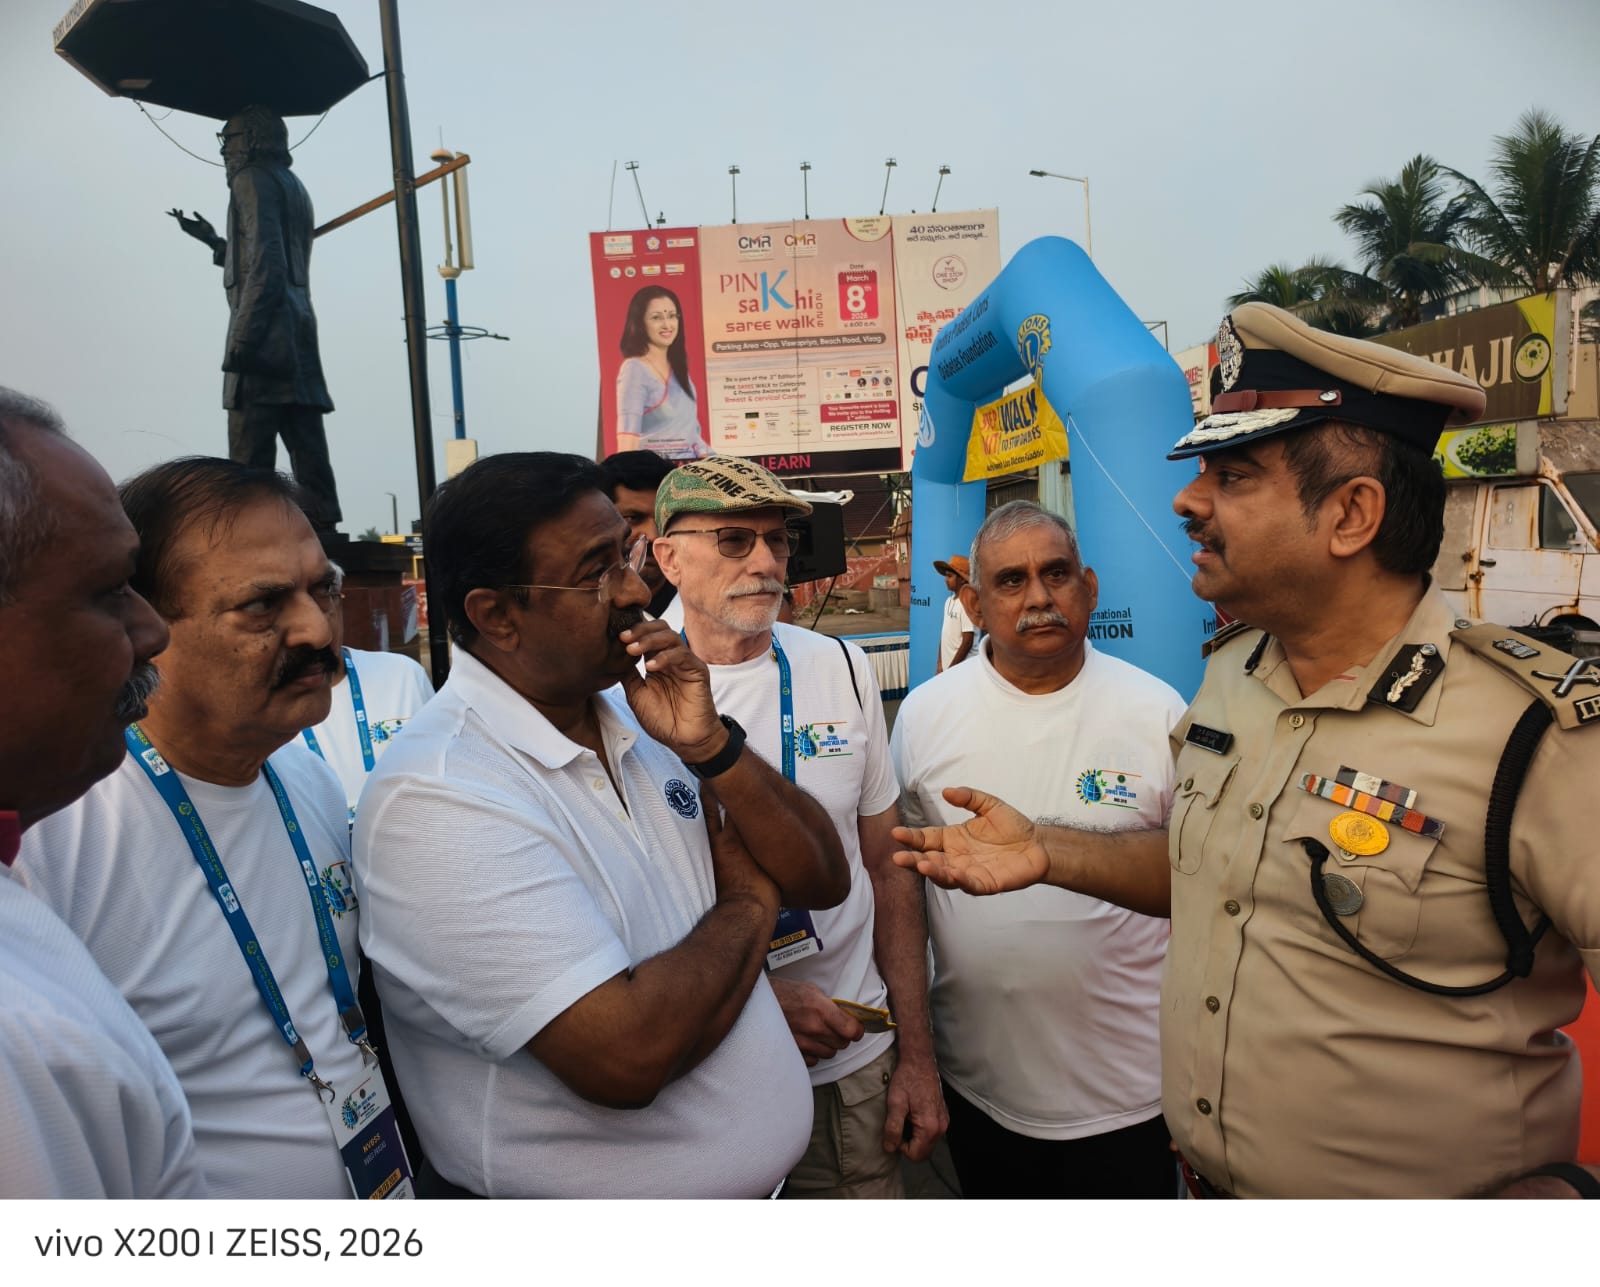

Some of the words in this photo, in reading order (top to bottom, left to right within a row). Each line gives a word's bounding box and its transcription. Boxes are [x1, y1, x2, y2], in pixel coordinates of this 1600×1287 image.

[910, 225, 925, 233] 40
[738, 235, 771, 249] CMR
[784, 233, 816, 247] CMR
[726, 319, 771, 333] saree
[776, 315, 815, 330] walk
[716, 342, 742, 351] Parking
[743, 341, 759, 349] Area
[820, 337, 841, 345] Beach
[958, 330, 999, 365] Foundation
[1420, 336, 1514, 388] HAJI
[1001, 387, 1038, 434] WALK
[830, 423, 869, 432] REGISTER
[872, 422, 892, 430] NOW
[706, 472, 747, 498] FINE
